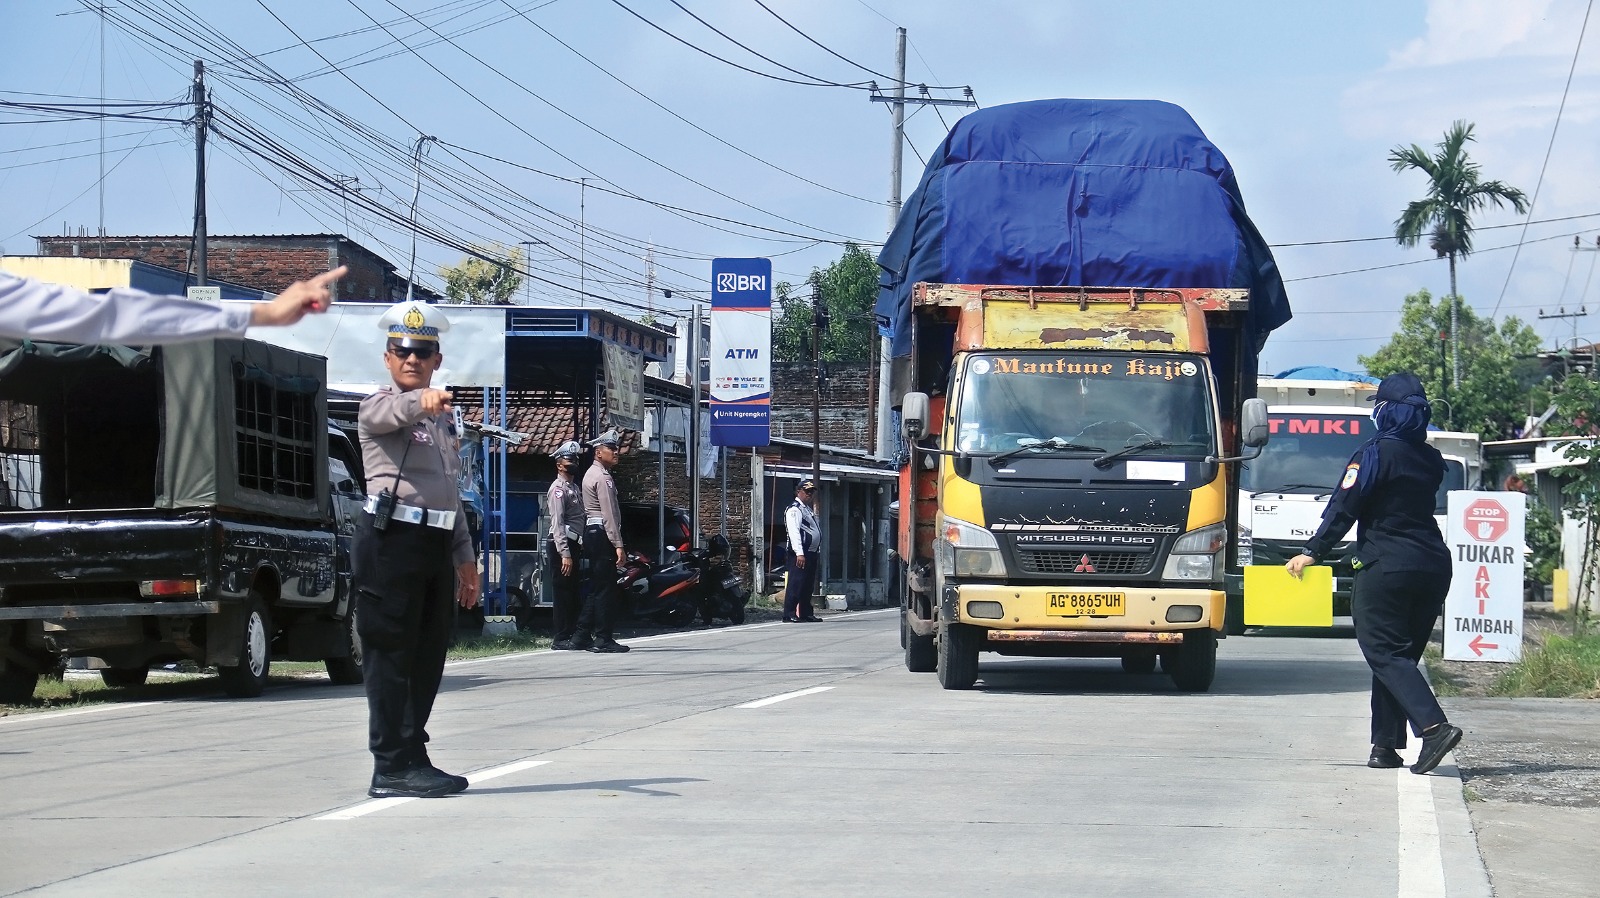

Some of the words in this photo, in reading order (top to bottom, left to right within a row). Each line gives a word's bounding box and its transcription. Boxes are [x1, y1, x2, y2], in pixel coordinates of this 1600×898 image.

[738, 275, 766, 291] BRI
[725, 348, 759, 359] ATM
[992, 357, 1113, 375] Mantune
[1126, 358, 1181, 380] Kaji
[1267, 418, 1360, 434] TMKI
[1472, 507, 1500, 516] STOP
[1016, 535, 1107, 543] MITSUBISHI
[1111, 536, 1155, 544] FUSO
[1291, 528, 1315, 536] ISU
[1456, 544, 1515, 564] TUKAR
[1475, 565, 1490, 615] AKI
[1050, 594, 1066, 608] AG
[1071, 594, 1102, 608] 8865
[1105, 594, 1121, 607] UH
[1454, 617, 1513, 635] TAMBAH
